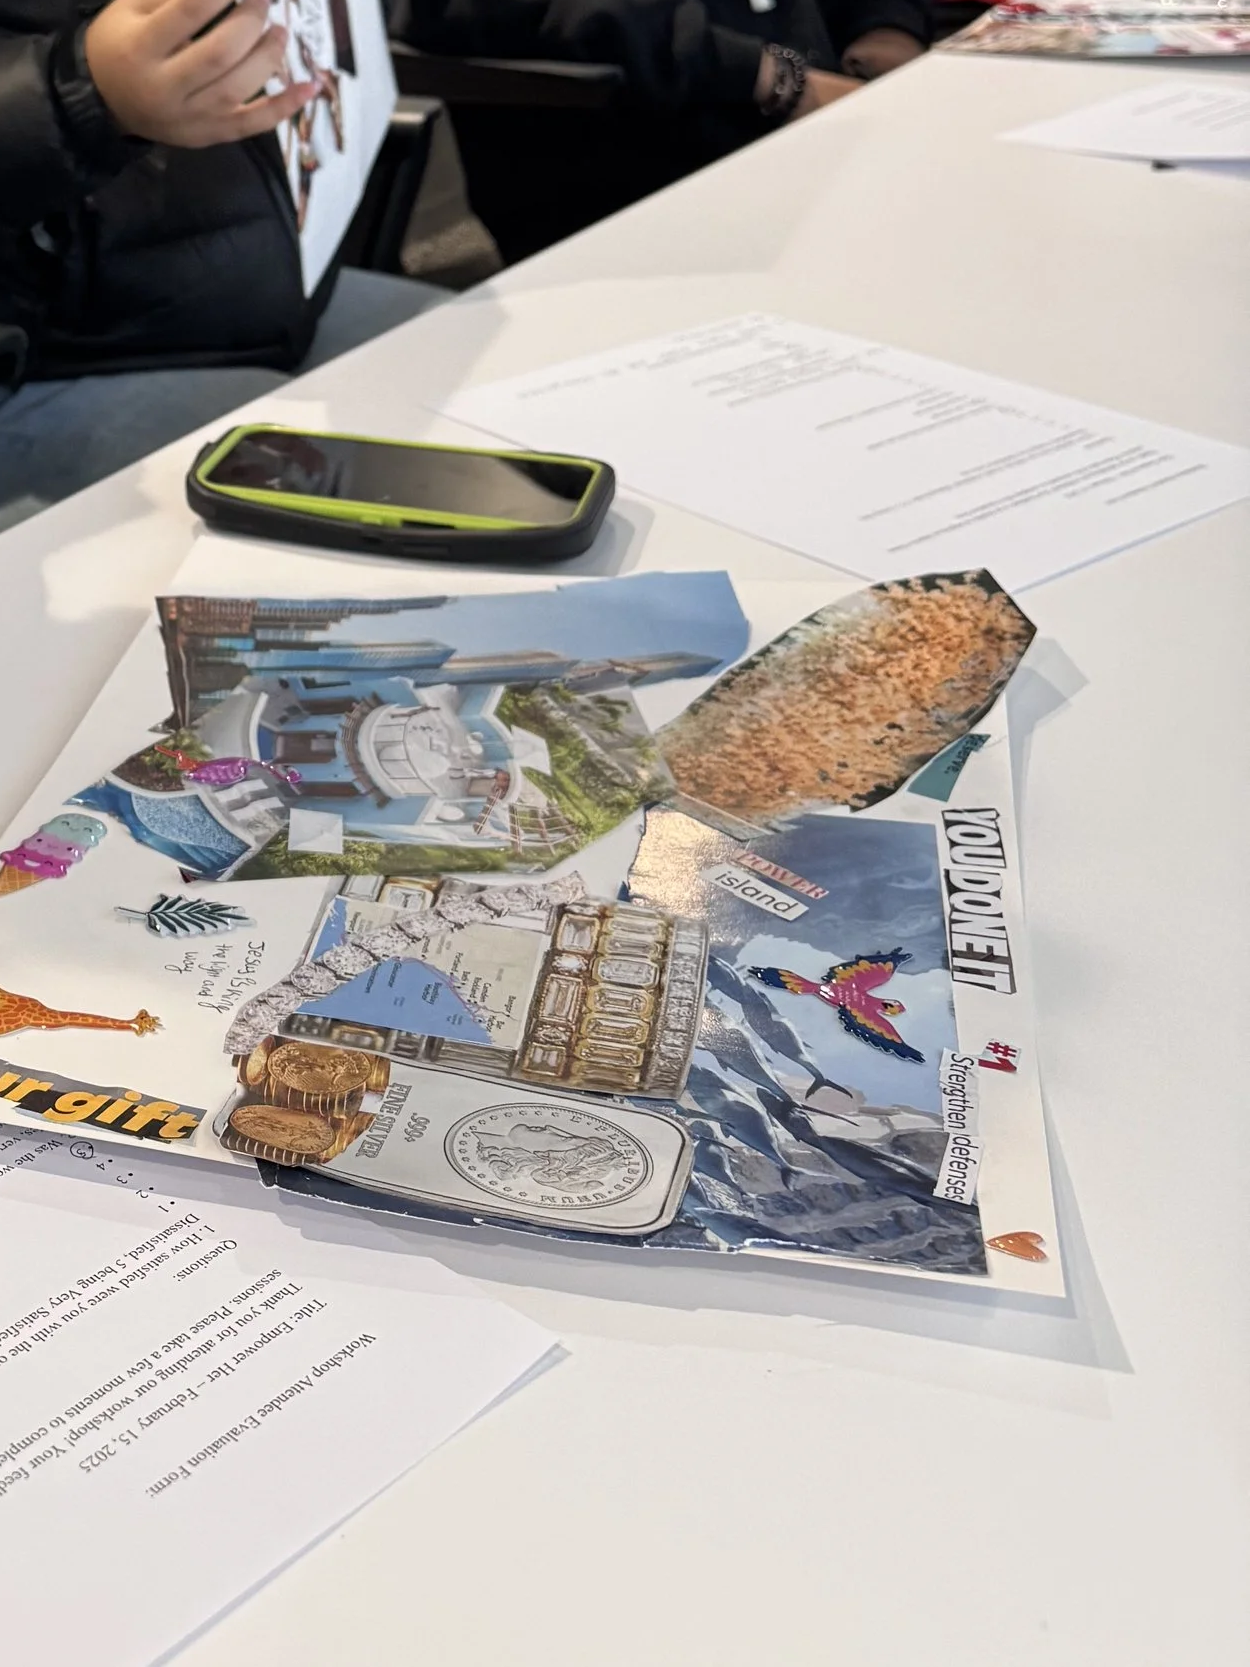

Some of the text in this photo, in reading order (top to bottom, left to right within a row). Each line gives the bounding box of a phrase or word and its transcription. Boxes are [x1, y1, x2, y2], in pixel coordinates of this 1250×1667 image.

[736, 852, 827, 897] POWER
[714, 870, 798, 913] island
[943, 809, 1013, 994] YOU DONE IT
[212, 943, 233, 959] the
[198, 980, 214, 996] and
[978, 1041, 1018, 1072] #1
[44, 1090, 200, 1139] gift
[355, 1082, 412, 1158] FINE SILVER
[18, 1127, 38, 1140] es,
[33, 1137, 64, 1155] Was
[14, 1153, 36, 1169] the
[76, 1148, 87, 1158] 5
[94, 1161, 108, 1171] 4
[944, 1134, 979, 1201] defenses
[116, 1174, 128, 1188] 3
[136, 1189, 149, 1198] 2
[158, 1203, 171, 1213] 1
[123, 1213, 201, 1262] Dissatisfied,
[166, 1226, 203, 1257] How
[194, 1221, 215, 1239] 1.
[113, 1258, 126, 1270] 5
[118, 1245, 171, 1288] satisfied
[170, 1240, 237, 1282] Questions:
[76, 1263, 118, 1292] being
[228, 1269, 282, 1308] sessions.
[47, 1288, 83, 1314] Very
[82, 1283, 122, 1307] were
[258, 1283, 303, 1310] Thank
[58, 1297, 89, 1323] you
[188, 1303, 234, 1335] Please
[233, 1304, 262, 1327] you
[289, 1299, 327, 1325] Title:
[29, 1317, 64, 1342] with
[214, 1320, 238, 1342] for
[3, 1341, 32, 1356] the
[161, 1332, 194, 1353] take
[230, 1321, 294, 1365] Empower
[126, 1358, 155, 1378] few
[152, 1351, 162, 1361] a
[154, 1339, 216, 1381] attending
[206, 1360, 236, 1382] Her
[64, 1375, 128, 1420] moments
[134, 1379, 158, 1398] our
[63, 1396, 136, 1448] workshop!
[137, 1388, 200, 1431] February
[145, 1334, 377, 1499] Workshop Attendee Evaluation Form:
[49, 1416, 68, 1429] to
[111, 1429, 139, 1446] 15,
[28, 1444, 68, 1469] Your
[79, 1443, 116, 1474] 2025
